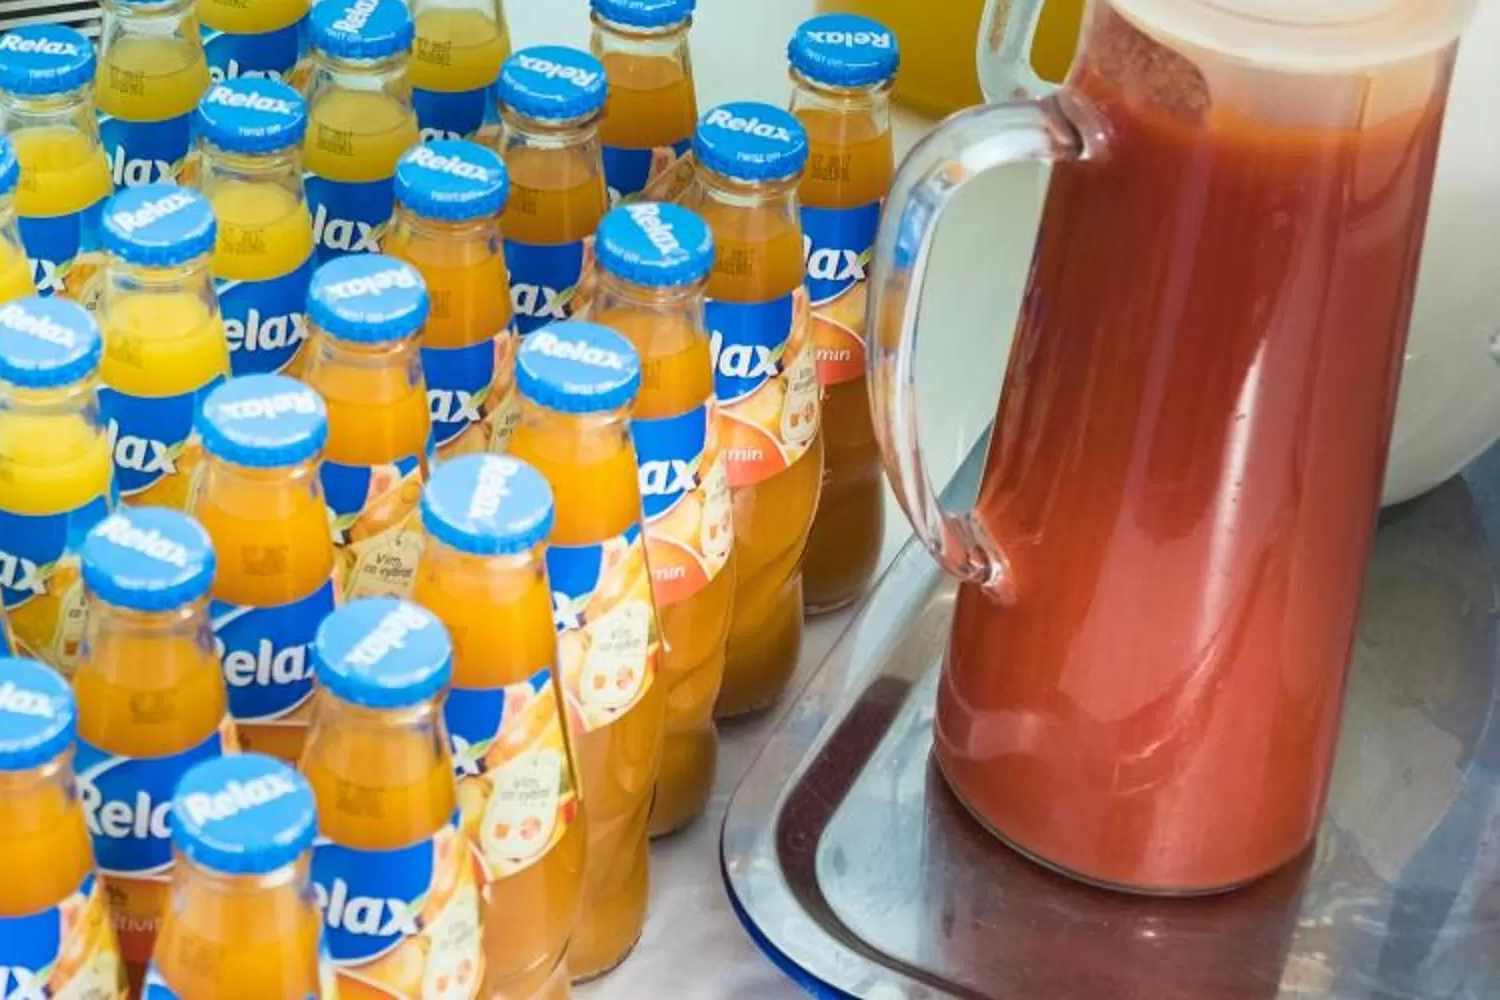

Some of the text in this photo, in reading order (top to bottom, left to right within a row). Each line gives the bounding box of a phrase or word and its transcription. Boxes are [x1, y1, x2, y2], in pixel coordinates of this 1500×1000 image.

[0, 35, 79, 56] Relax
[806, 31, 890, 49] Relax
[516, 54, 598, 87] Relax
[207, 87, 292, 114] Relax
[706, 109, 791, 143] Relax
[112, 144, 180, 187] lax
[406, 147, 490, 182] Relax
[112, 191, 196, 233] Relax
[314, 204, 380, 252] lax
[804, 234, 866, 280] lax
[323, 266, 418, 300] Relax
[225, 308, 308, 351] elax
[529, 331, 624, 370] Relax
[709, 330, 778, 378] lax
[108, 418, 176, 474] lax
[95, 514, 188, 568] Relax
[215, 637, 314, 687] ela
[77, 776, 173, 839] Rela
[185, 773, 298, 826] Relax
[312, 878, 420, 935] lax
